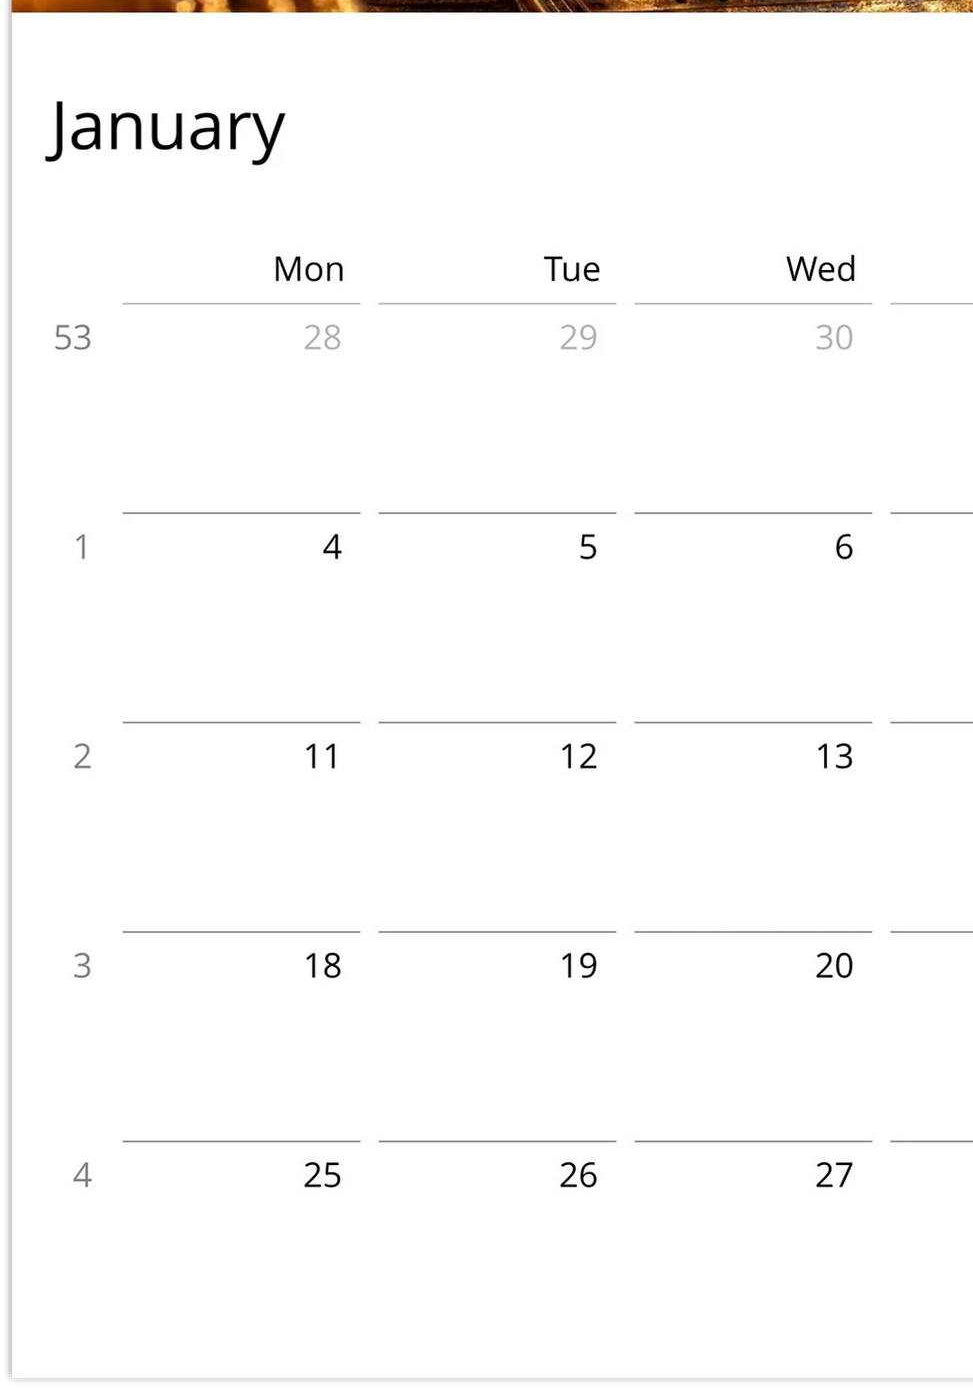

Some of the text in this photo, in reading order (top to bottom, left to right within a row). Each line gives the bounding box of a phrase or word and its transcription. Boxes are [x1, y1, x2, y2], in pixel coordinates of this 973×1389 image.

[44, 100, 287, 167] January
[274, 255, 344, 283] Mon
[543, 255, 601, 283] Tue
[785, 253, 856, 283] Wed
[54, 323, 92, 351] 53
[304, 324, 341, 351] 28
[560, 324, 597, 351] 29
[816, 324, 853, 351] 30
[75, 533, 86, 560] 1
[322, 533, 343, 560] 4
[579, 533, 598, 561] 5
[835, 532, 854, 561] 6
[73, 742, 92, 770] 2
[305, 742, 336, 770] 11
[561, 742, 598, 770] 12
[817, 742, 854, 770] 13
[73, 952, 92, 979] 3
[305, 951, 342, 979] 18
[561, 951, 598, 979] 19
[815, 951, 854, 979] 20
[72, 1161, 93, 1188] 4
[303, 1161, 342, 1189] 25
[559, 1161, 598, 1189] 26
[815, 1161, 854, 1189] 27
